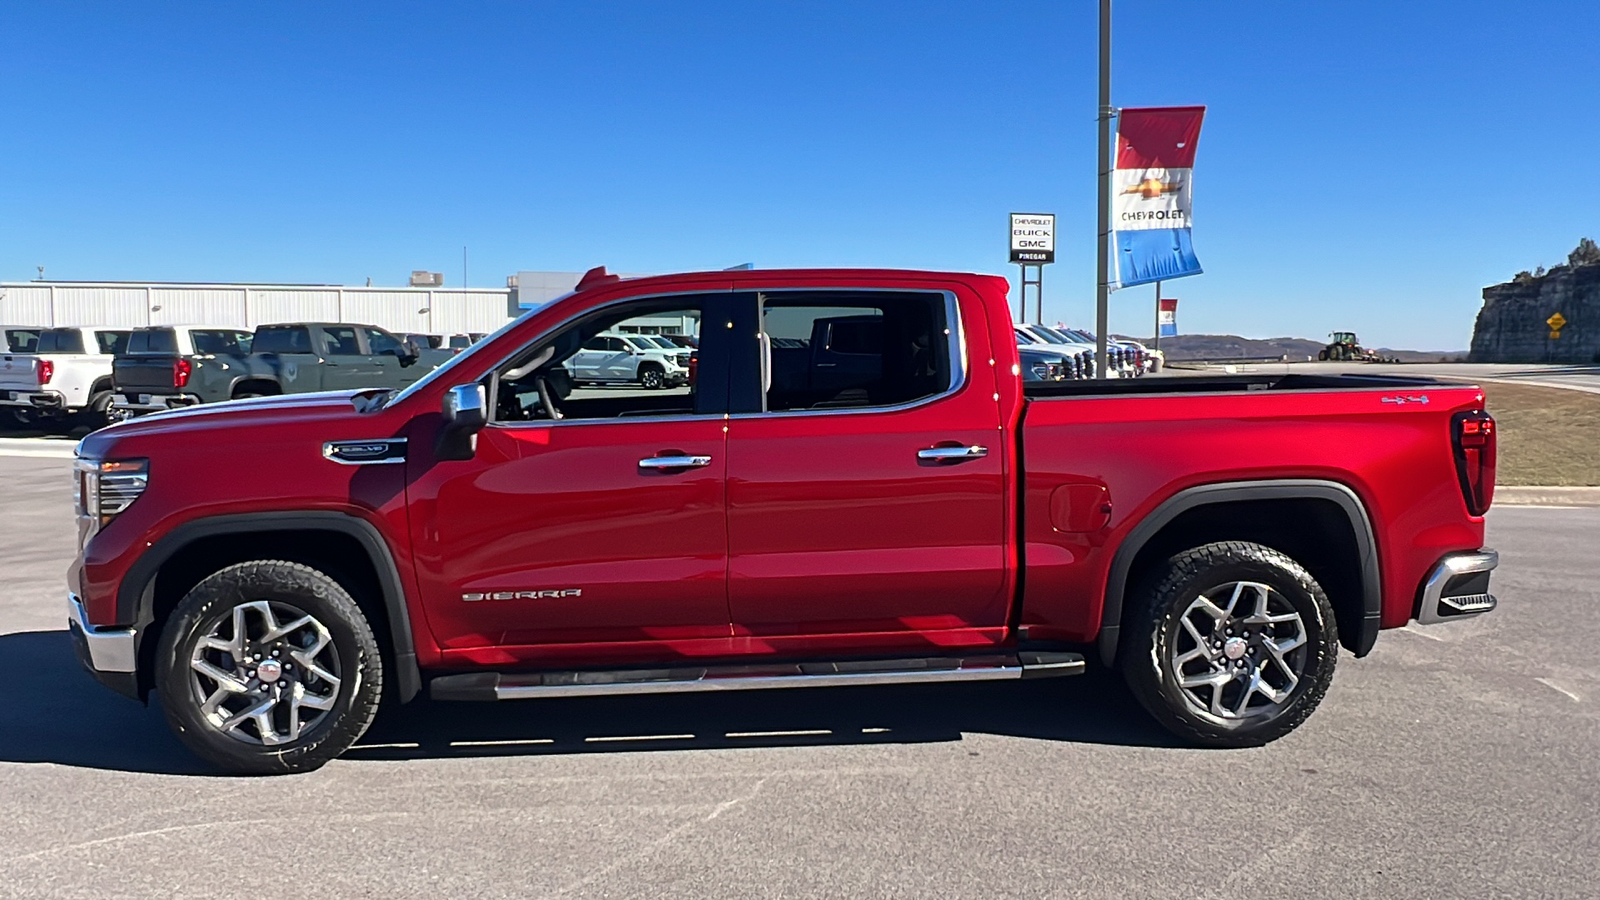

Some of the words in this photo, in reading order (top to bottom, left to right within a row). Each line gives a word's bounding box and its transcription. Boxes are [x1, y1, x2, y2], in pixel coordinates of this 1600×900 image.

[1122, 209, 1183, 221] CHEVROLET
[1013, 229, 1051, 237] BUICK
[1018, 240, 1046, 248] GMC
[462, 589, 581, 601] SIERRA
